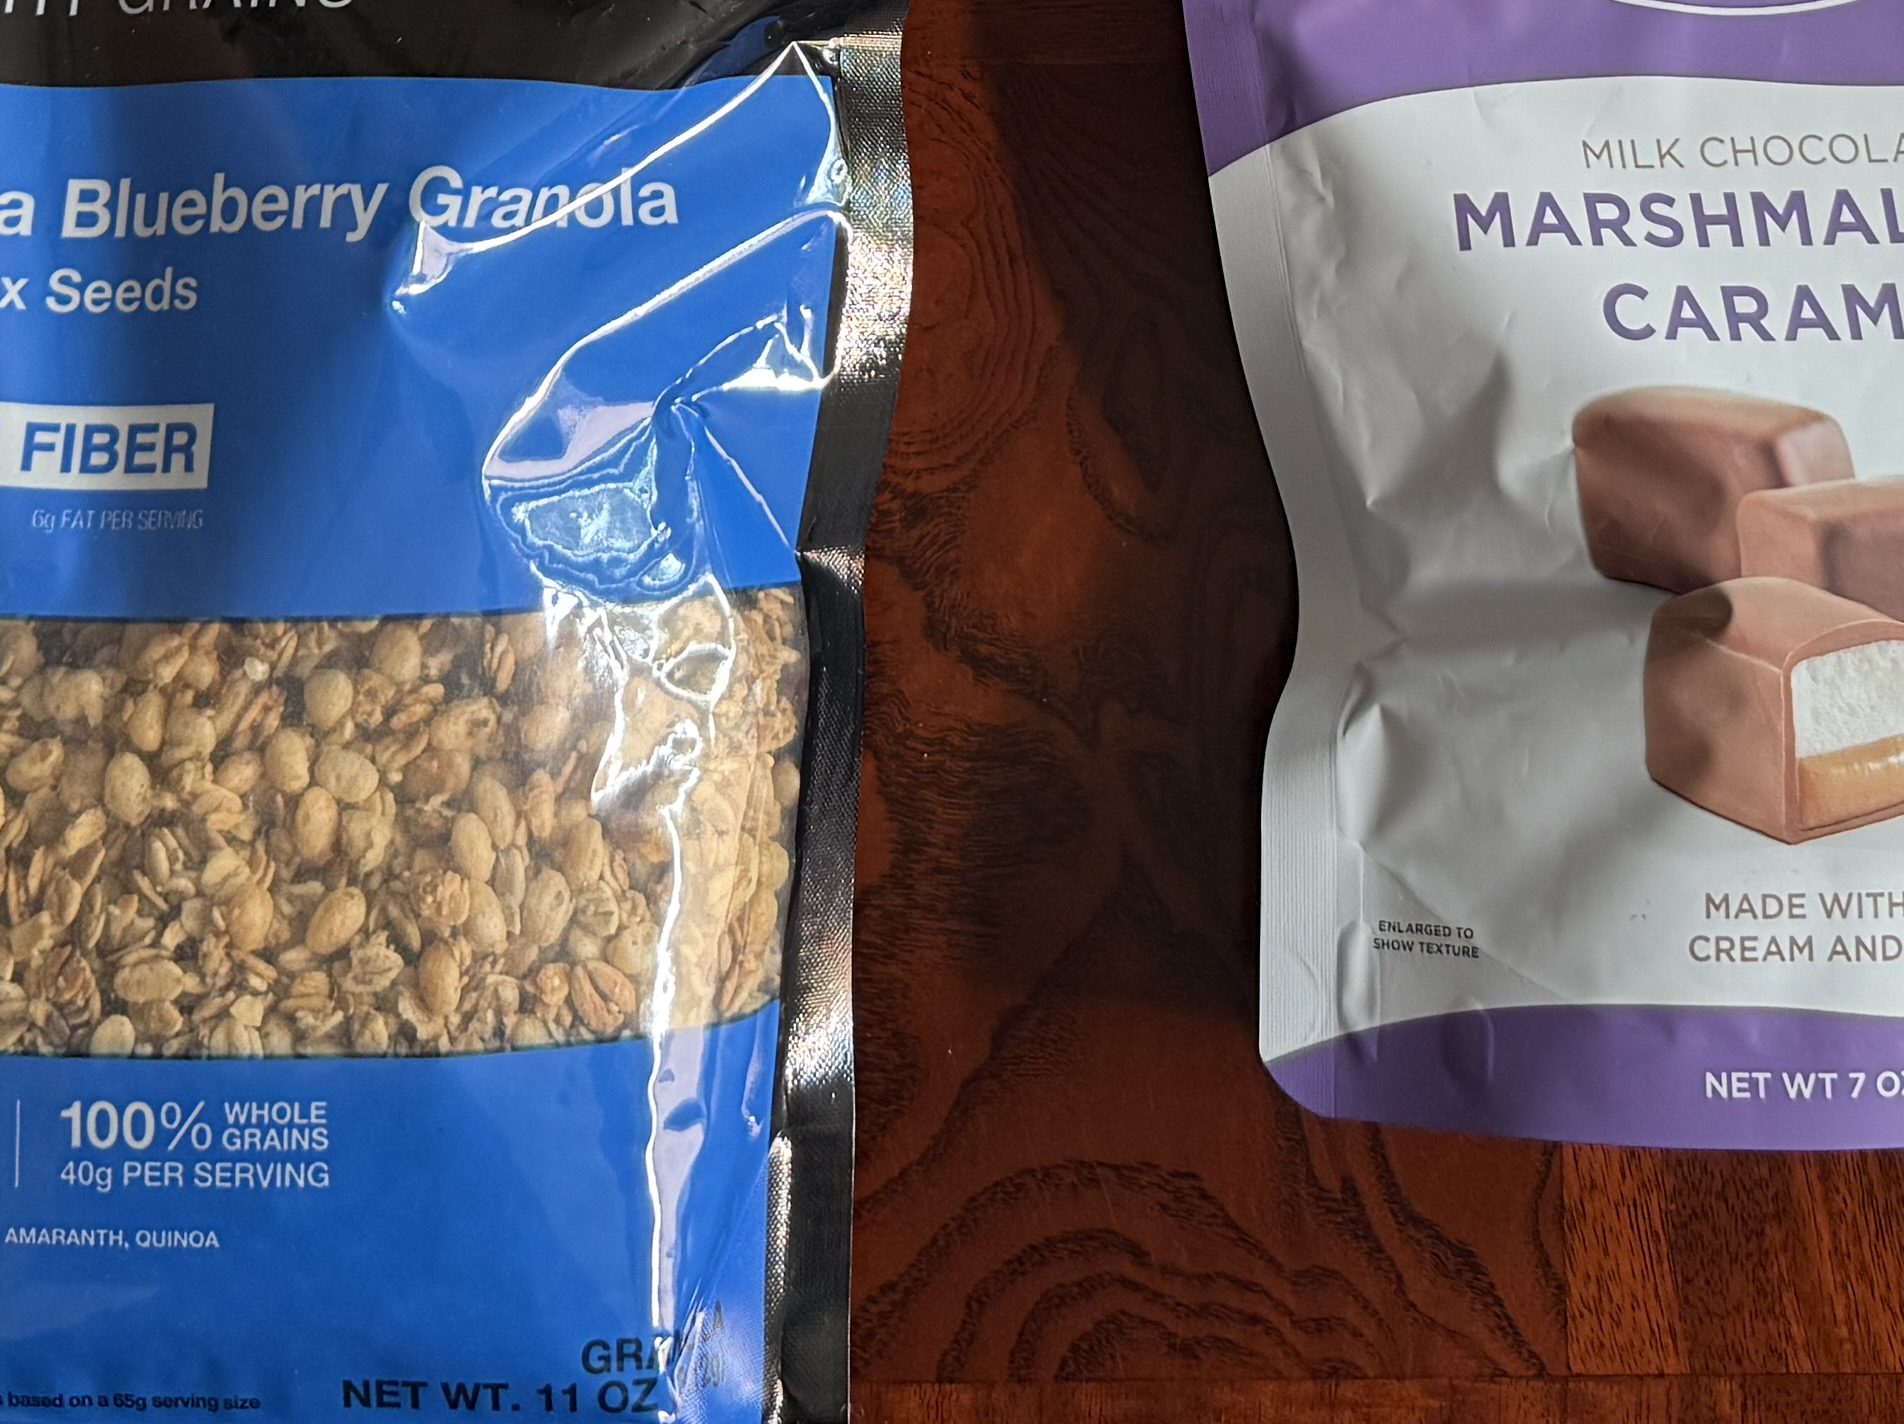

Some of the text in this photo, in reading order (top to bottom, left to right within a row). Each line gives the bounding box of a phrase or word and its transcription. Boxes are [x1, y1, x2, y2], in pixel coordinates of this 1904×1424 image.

[1581, 137, 1685, 169] MILK
[1703, 891, 1806, 921] MADE
[1378, 920, 1473, 939] ENLARGED TO
[1373, 938, 1480, 958] SHOW TEXTURE
[1688, 935, 1816, 963] CREAM
[1825, 934, 1903, 962] AND
[1705, 1071, 1770, 1100] NET
[1781, 1071, 1838, 1100] WT
[1848, 1071, 1866, 1098] 7
[60, 1100, 327, 1152] 100% WHOLE
[222, 1128, 329, 1152] GRAINS
